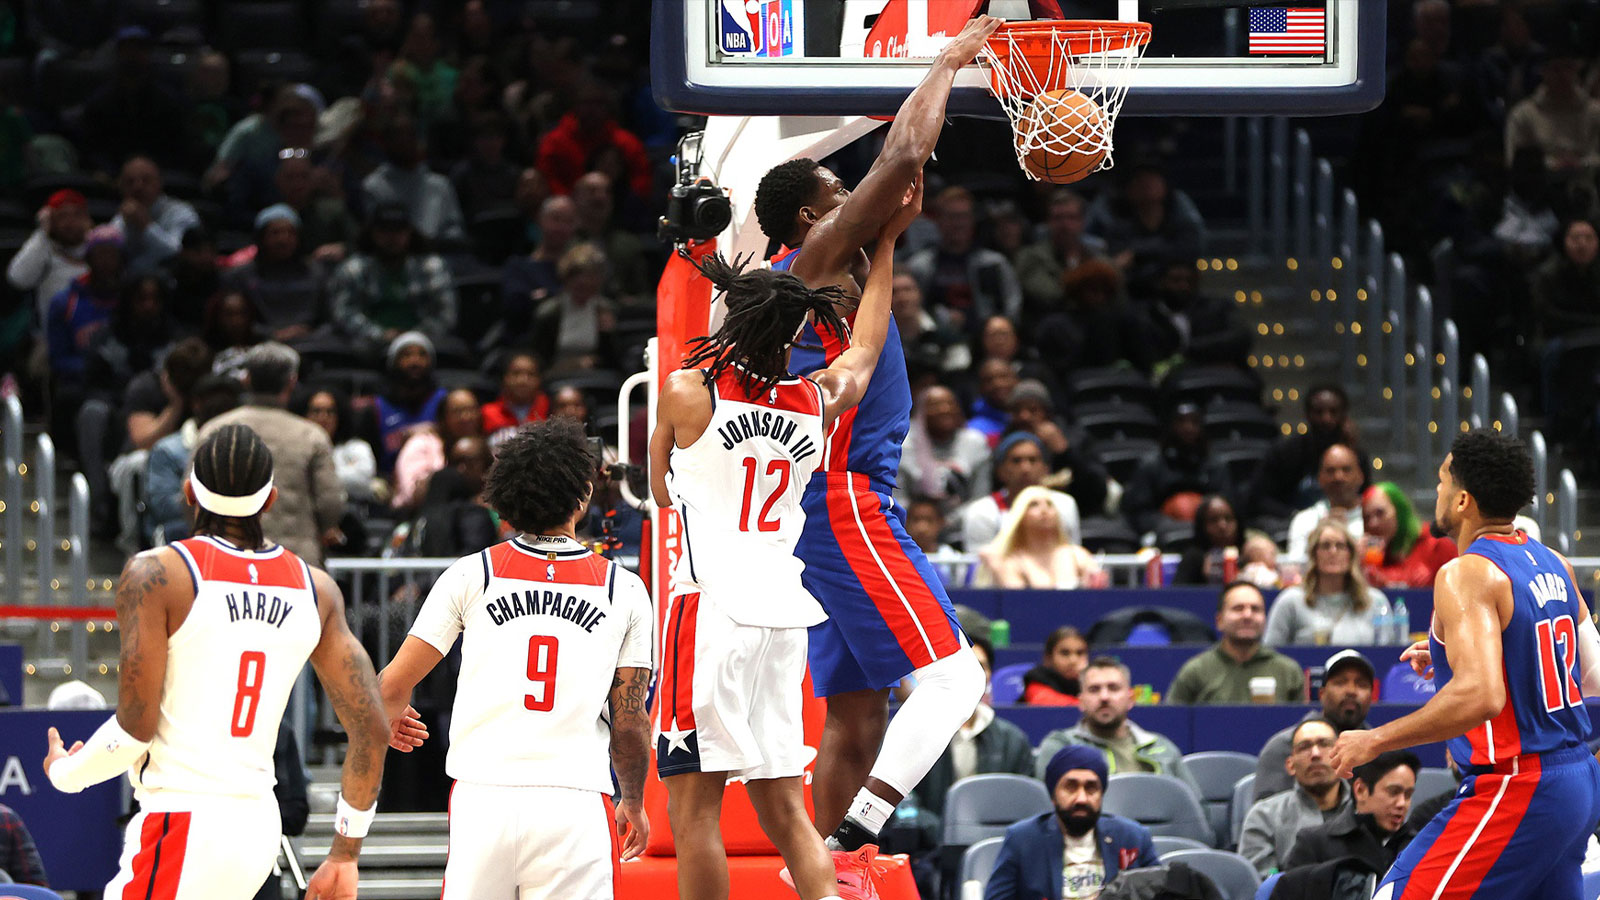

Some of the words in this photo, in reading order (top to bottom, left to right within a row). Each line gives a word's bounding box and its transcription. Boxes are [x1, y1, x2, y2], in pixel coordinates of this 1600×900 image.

[726, 32, 747, 49] NBA
[717, 410, 798, 451] JOHNSON
[789, 434, 816, 463] III
[739, 456, 790, 532] 12
[536, 534, 553, 543] NIKE
[553, 536, 568, 544] PRO
[225, 591, 293, 629] HARDY
[486, 589, 607, 633] CHAMPAGNIE
[524, 634, 559, 712] 9
[1535, 614, 1583, 713] 12
[231, 650, 266, 738] 8
